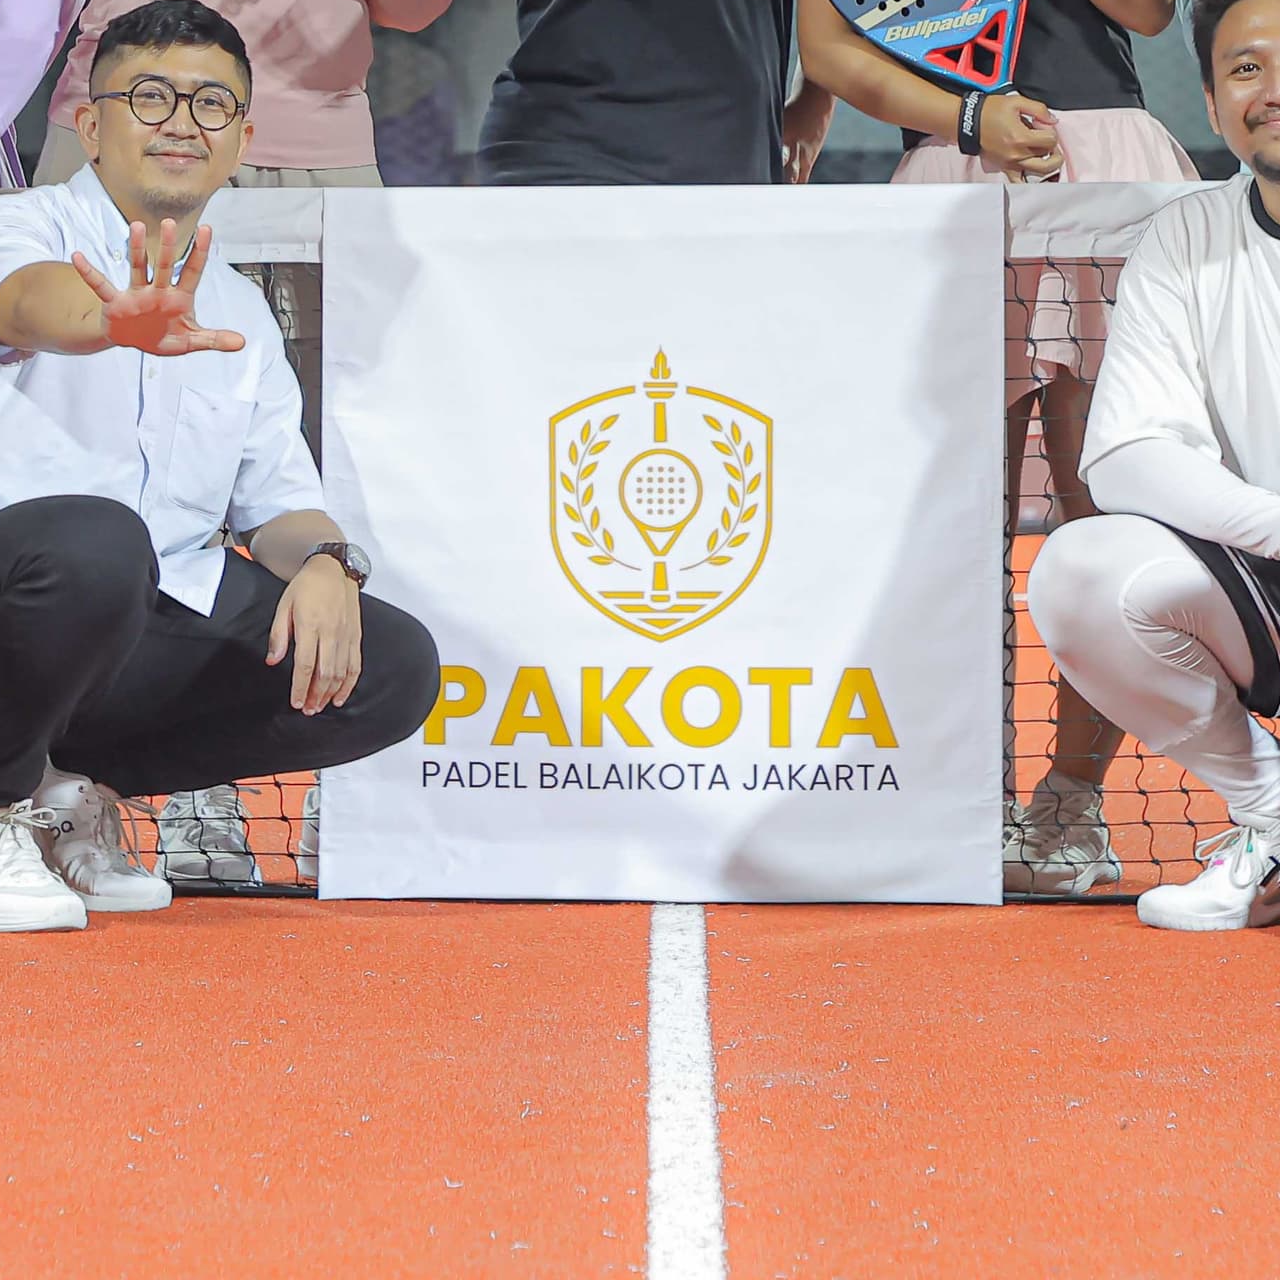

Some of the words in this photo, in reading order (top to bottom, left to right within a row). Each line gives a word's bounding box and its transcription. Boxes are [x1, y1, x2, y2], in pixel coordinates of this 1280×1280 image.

[884, 8, 988, 42] Bullpadel
[962, 90, 981, 136] ullpadel
[423, 665, 900, 748] PAKOTA
[422, 761, 527, 789] PADEL
[540, 762, 731, 790] BALAIKOTA
[742, 764, 900, 791] JAKARTA
